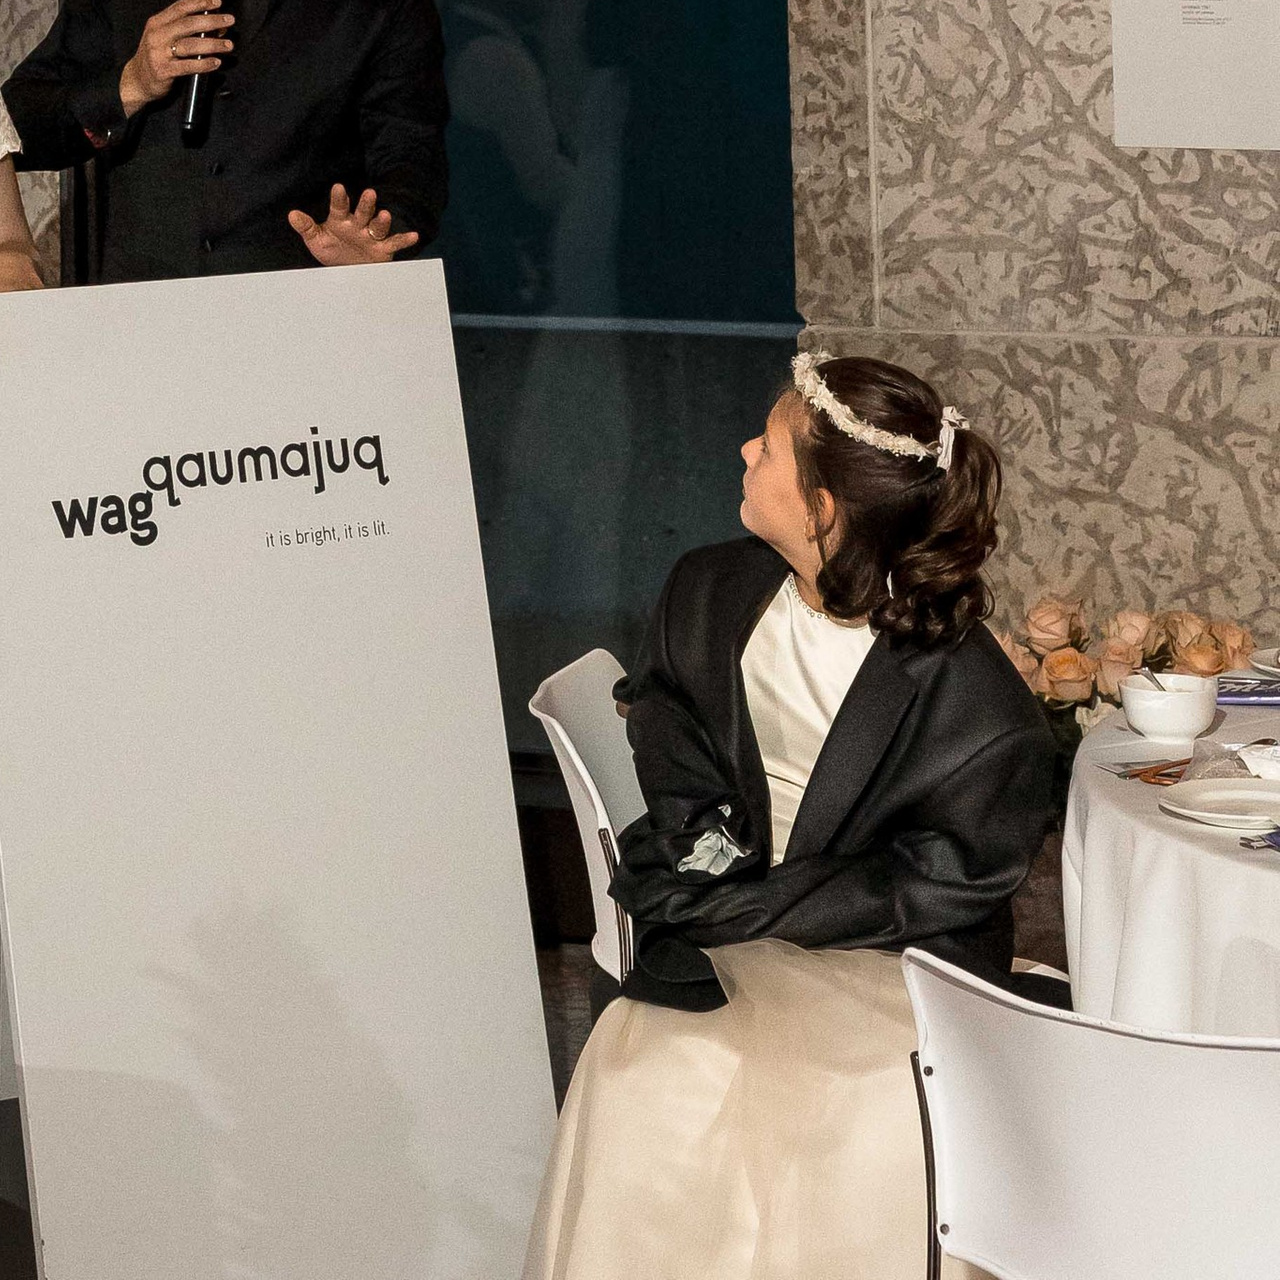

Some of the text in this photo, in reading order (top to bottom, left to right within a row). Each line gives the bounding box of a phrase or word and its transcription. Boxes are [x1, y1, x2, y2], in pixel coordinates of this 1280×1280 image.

[143, 426, 390, 508] qaumajuq
[52, 490, 159, 547] wag
[266, 519, 390, 548] it is bright, it is lit.
